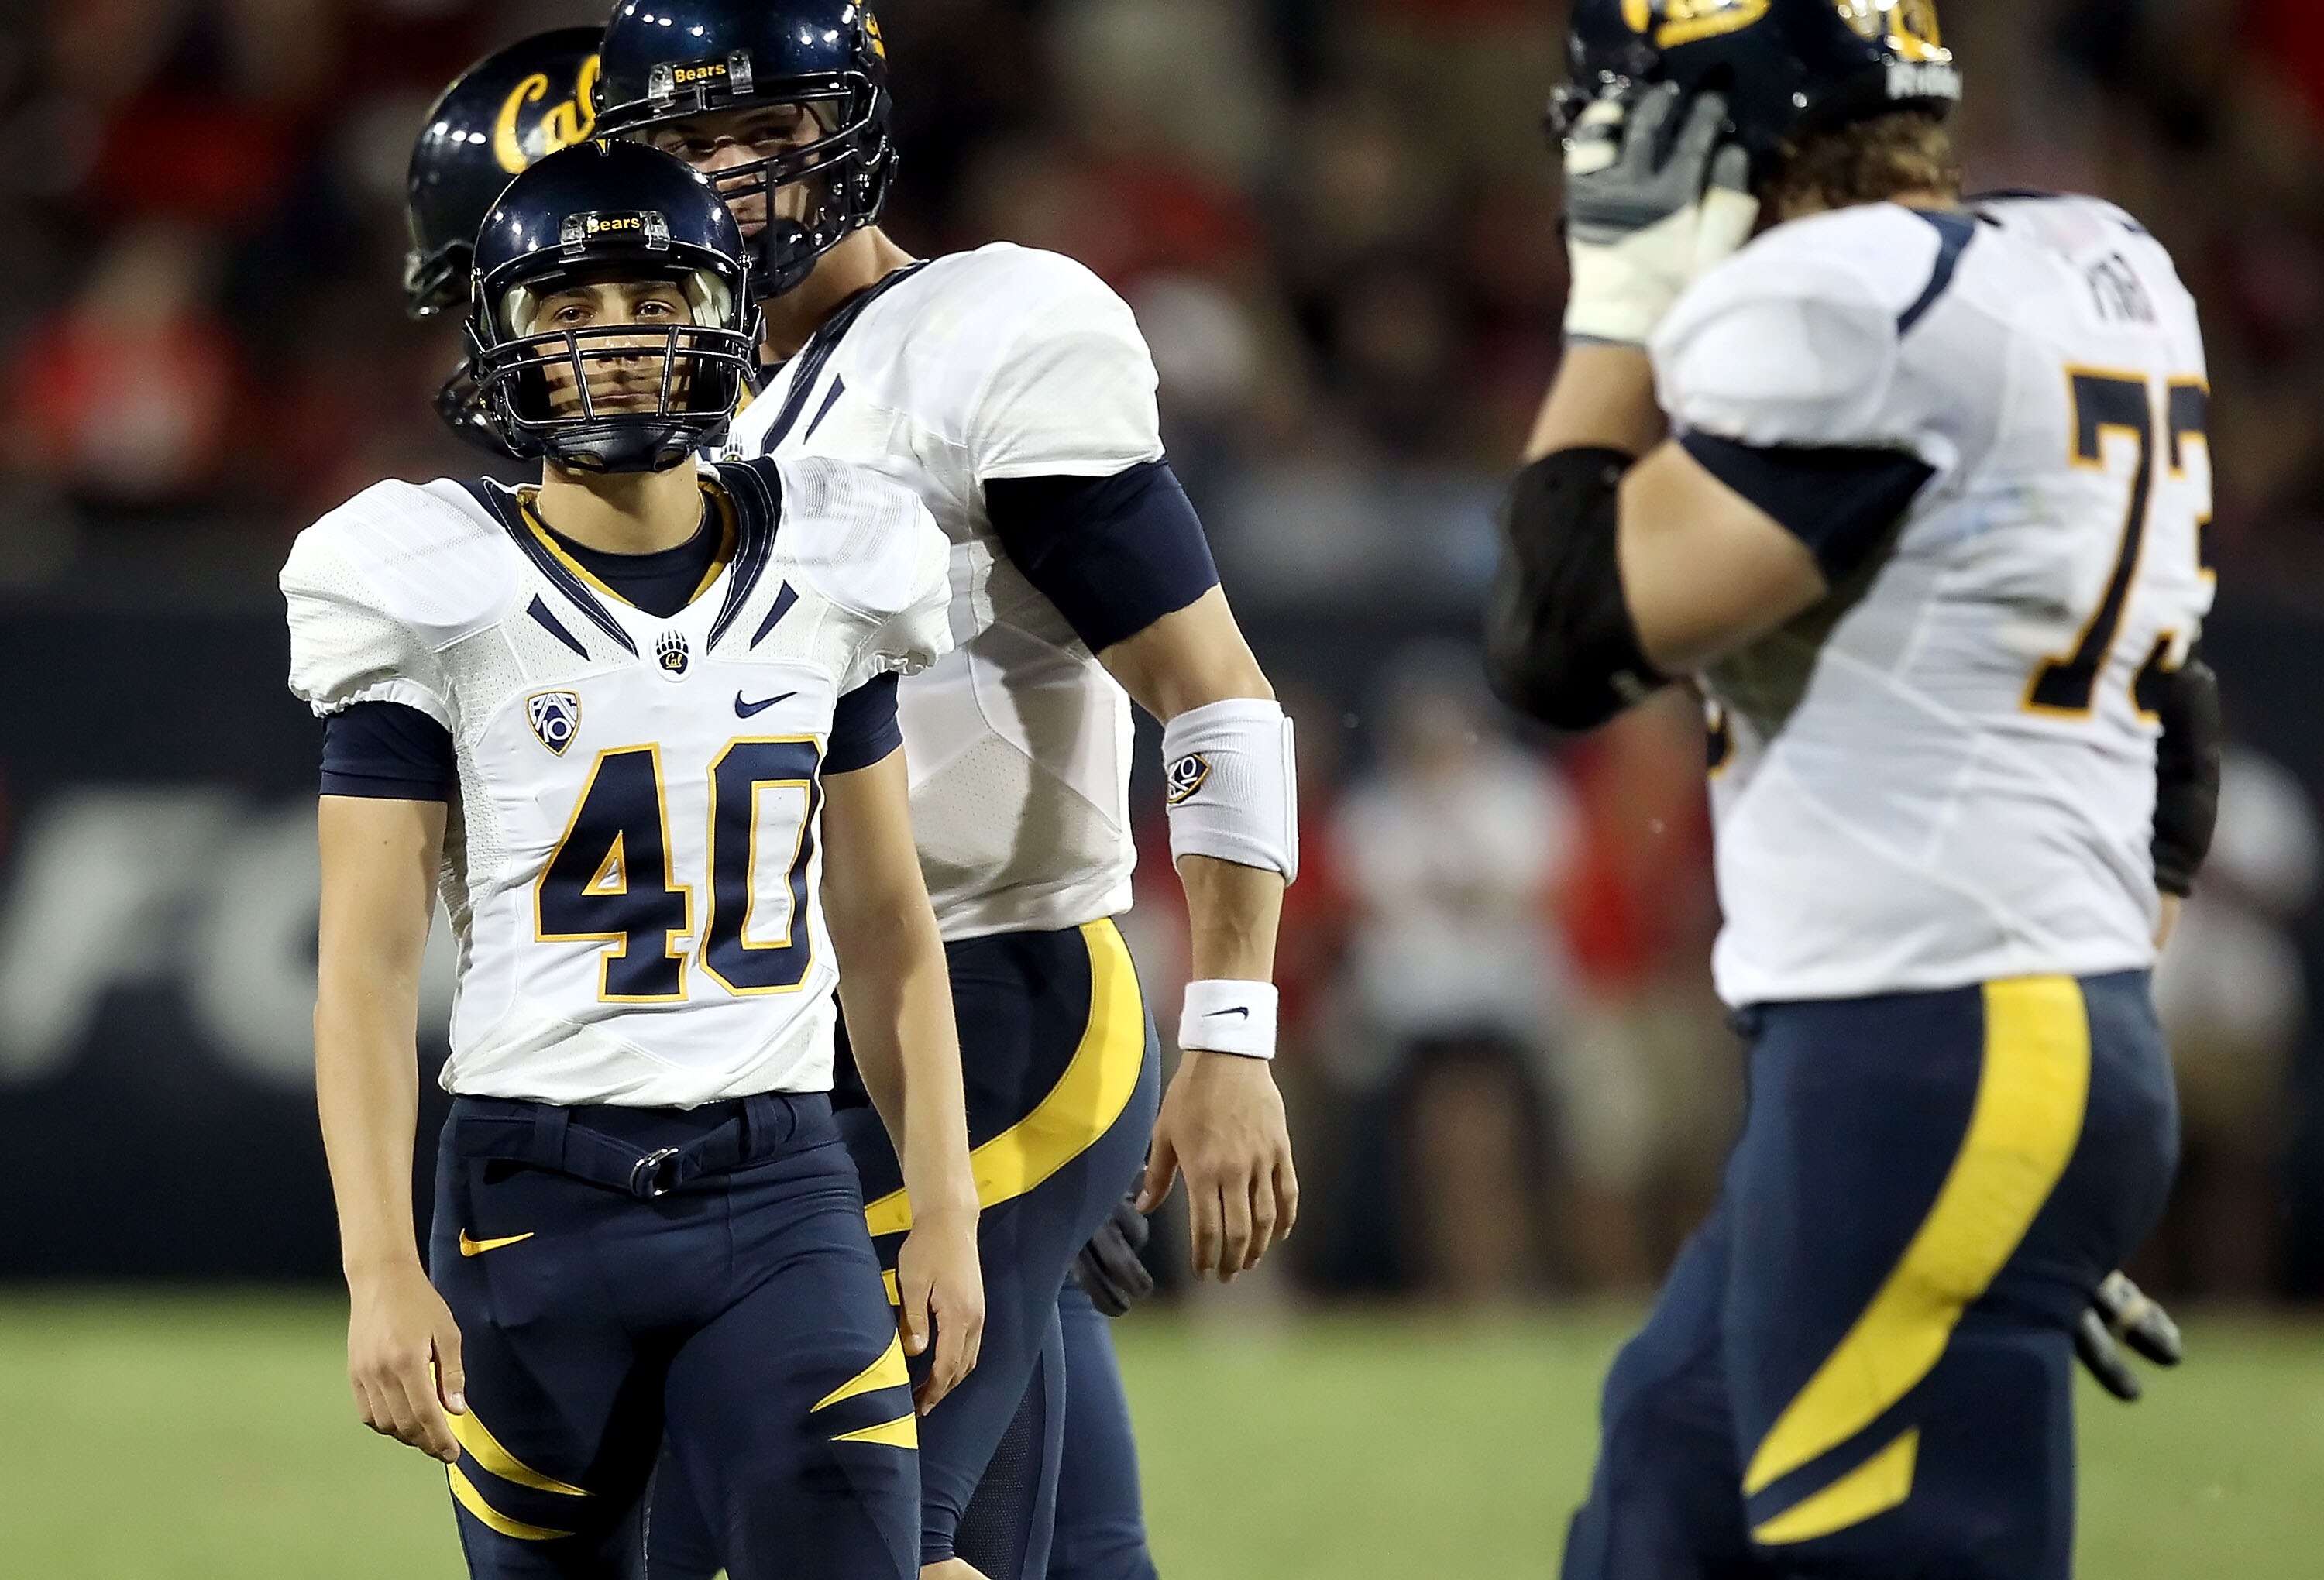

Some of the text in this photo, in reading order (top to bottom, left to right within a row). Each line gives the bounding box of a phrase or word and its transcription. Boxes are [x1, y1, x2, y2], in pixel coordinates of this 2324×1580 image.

[674, 64, 727, 83] Bears
[493, 54, 600, 175] Cal
[587, 218, 641, 234] Bears
[665, 652, 682, 668] Cal
[528, 692, 578, 732] PAC
[542, 717, 572, 743] 10
[535, 734, 825, 1002] 40
